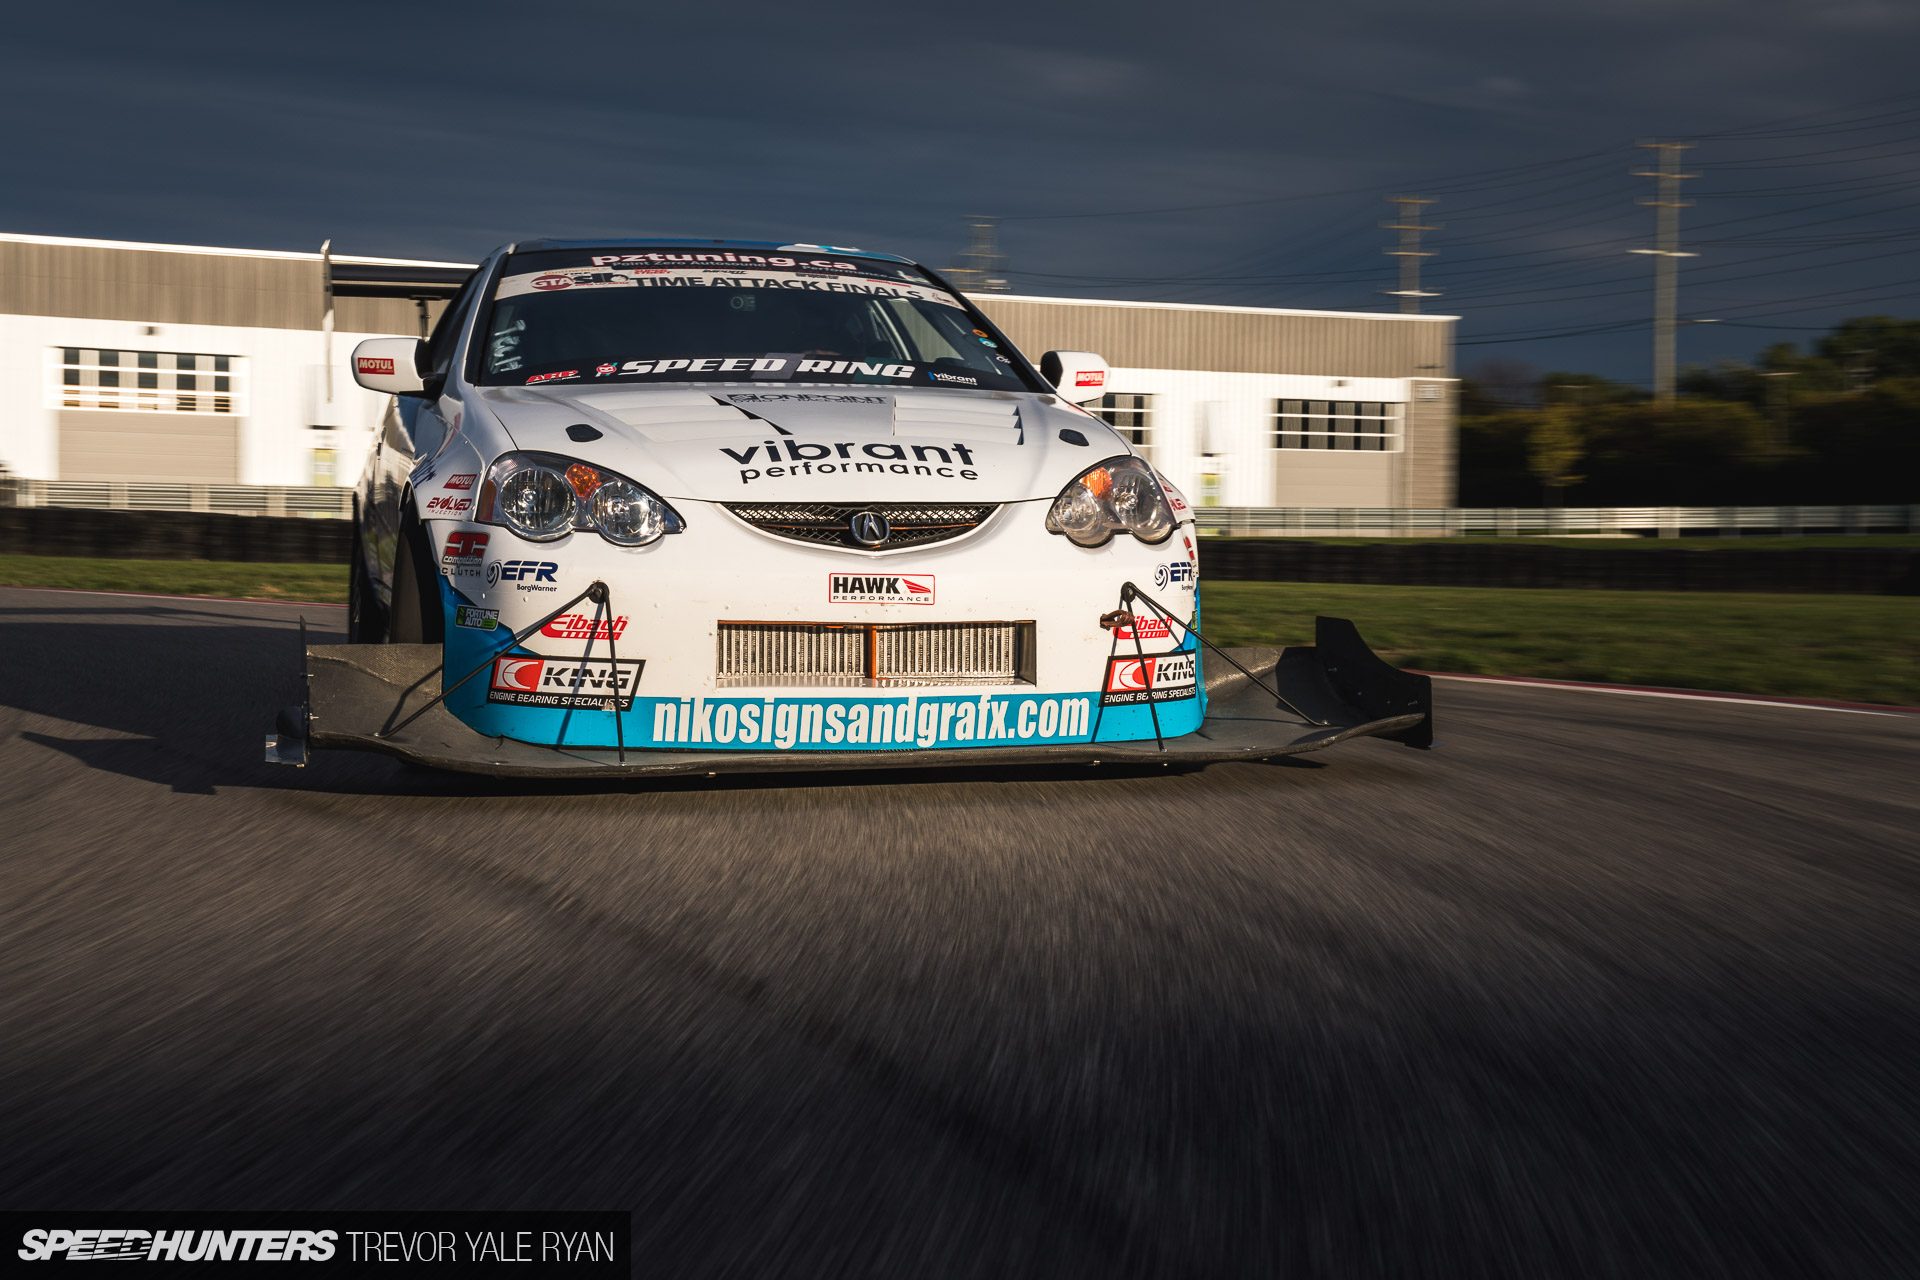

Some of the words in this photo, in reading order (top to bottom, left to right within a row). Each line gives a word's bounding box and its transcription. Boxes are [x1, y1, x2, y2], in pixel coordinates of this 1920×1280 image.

[591, 252, 858, 271] pztuning.ca
[531, 277, 574, 288] GTA
[629, 276, 706, 287] TIME
[711, 277, 824, 291] ATTACK
[825, 282, 925, 300] FINALS
[359, 358, 393, 370] MOTUL
[618, 358, 788, 376] SPEED
[796, 359, 916, 379] RING
[526, 370, 580, 384] ARP
[933, 373, 977, 383] vibrant
[1076, 372, 1104, 382] MOTUL
[719, 439, 975, 466] vibrant
[448, 475, 475, 485] MOTUL
[740, 462, 979, 484] performance
[426, 495, 473, 511] EVOLVED
[441, 567, 481, 577] CLUTCH
[501, 560, 559, 583] EFR
[516, 583, 558, 593] BorgWarner
[833, 576, 901, 594] HAWK
[465, 608, 498, 620] FORTUNE
[465, 618, 483, 627] AUTO
[541, 614, 628, 640] Eibach
[543, 667, 632, 690] KING
[489, 690, 517, 702] ENGINE
[517, 693, 559, 705] BEARING
[560, 696, 630, 708] SPECIALISS
[1104, 693, 1135, 703] ENGINE
[652, 695, 1090, 750] nikosignsandgrafx.com
